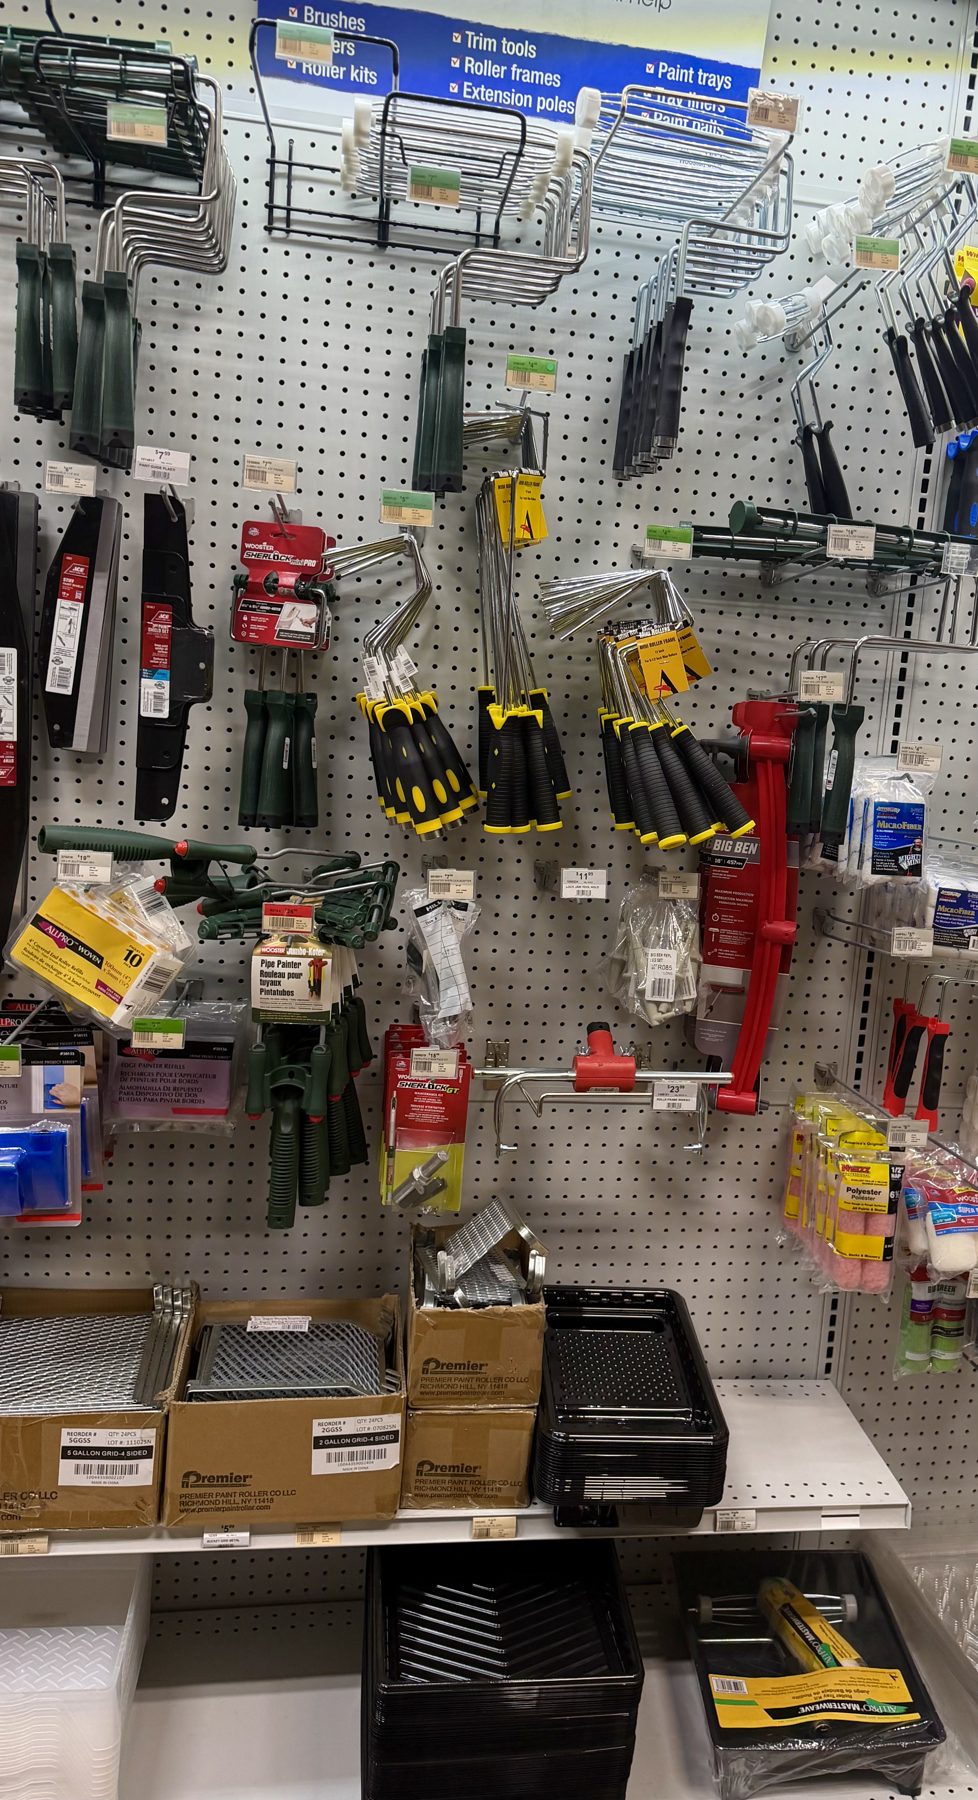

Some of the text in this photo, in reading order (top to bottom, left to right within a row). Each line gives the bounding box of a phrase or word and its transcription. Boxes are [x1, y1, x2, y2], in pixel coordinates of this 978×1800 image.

[304, 5, 366, 32] Brushes
[465, 31, 537, 59] Trim tools
[350, 64, 378, 85] kits
[464, 56, 561, 88] Roller frames
[658, 61, 732, 92] Paint trays
[462, 81, 575, 115] Extension poles
[244, 542, 274, 551] WOOSTER
[245, 551, 293, 563] SHERLOCK
[713, 839, 758, 855] BIG BEN
[78, 945, 102, 964] WOVEN
[123, 948, 142, 968] 10
[58, 958, 71, 968] Roller
[71, 964, 84, 976] Refills
[260, 959, 302, 969] Pipe Painter
[260, 970, 303, 980] Rouleau pour
[260, 980, 282, 988] tuyaux
[260, 988, 294, 996] Pintatubos
[398, 1081, 447, 1092] SHERLOCK
[846, 1186, 882, 1196] Polyester
[422, 1357, 488, 1375] Premier
[416, 1460, 482, 1476] Premier
[182, 1470, 252, 1488] Premier
[38, 1490, 58, 1500] LLC
[180, 1499, 221, 1507] RICHMOND
[800, 1702, 897, 1714] ALLPRO MASTERWEAVE
